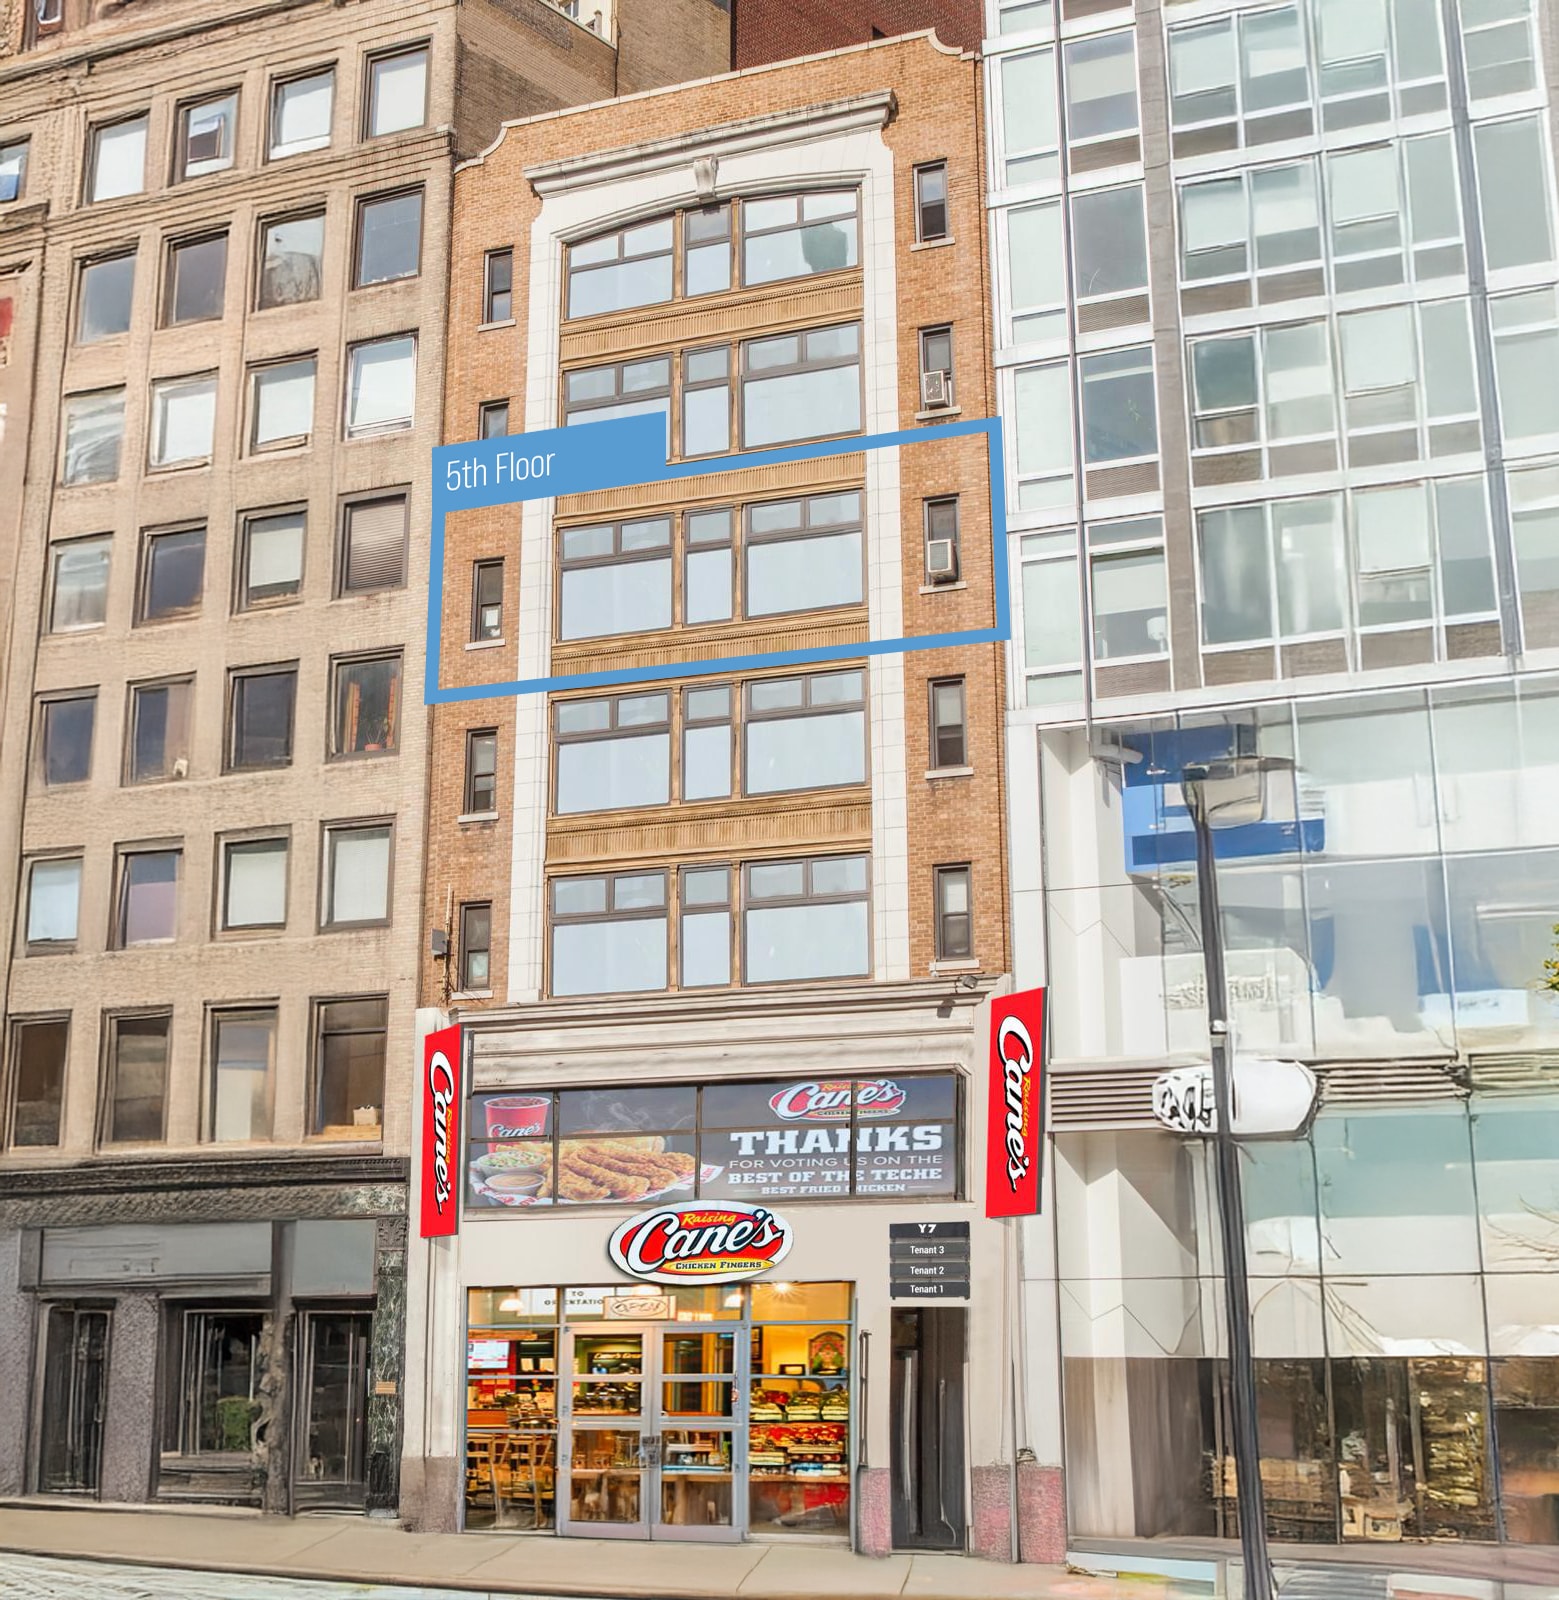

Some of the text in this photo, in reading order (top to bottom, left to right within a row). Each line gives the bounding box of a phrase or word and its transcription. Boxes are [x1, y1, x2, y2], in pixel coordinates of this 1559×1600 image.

[777, 1080, 904, 1119] Cane's
[997, 1014, 1034, 1193] Cane's
[1021, 1076, 1031, 1138] Raising
[429, 1050, 455, 1216] Cane's
[730, 1125, 942, 1156] THANKS
[729, 1159, 764, 1169] FOR
[770, 1157, 838, 1168] VOTING
[873, 1156, 901, 1166] ON
[907, 1154, 943, 1164] THE
[727, 1172, 783, 1185] BEST
[788, 1171, 816, 1183] OF
[821, 1169, 865, 1182] THE
[870, 1168, 942, 1180] TECHE
[761, 1186, 796, 1195] BEST
[800, 1185, 841, 1194] FRIED
[681, 1212, 738, 1226] Raising
[918, 1223, 937, 1234] Y7
[626, 1209, 785, 1274] Cane's
[910, 1245, 945, 1255] Tenant 3
[675, 1260, 762, 1270] CHICKEN FINGERS
[910, 1266, 945, 1275] Tenant 2
[910, 1284, 944, 1294] Tenant 1
